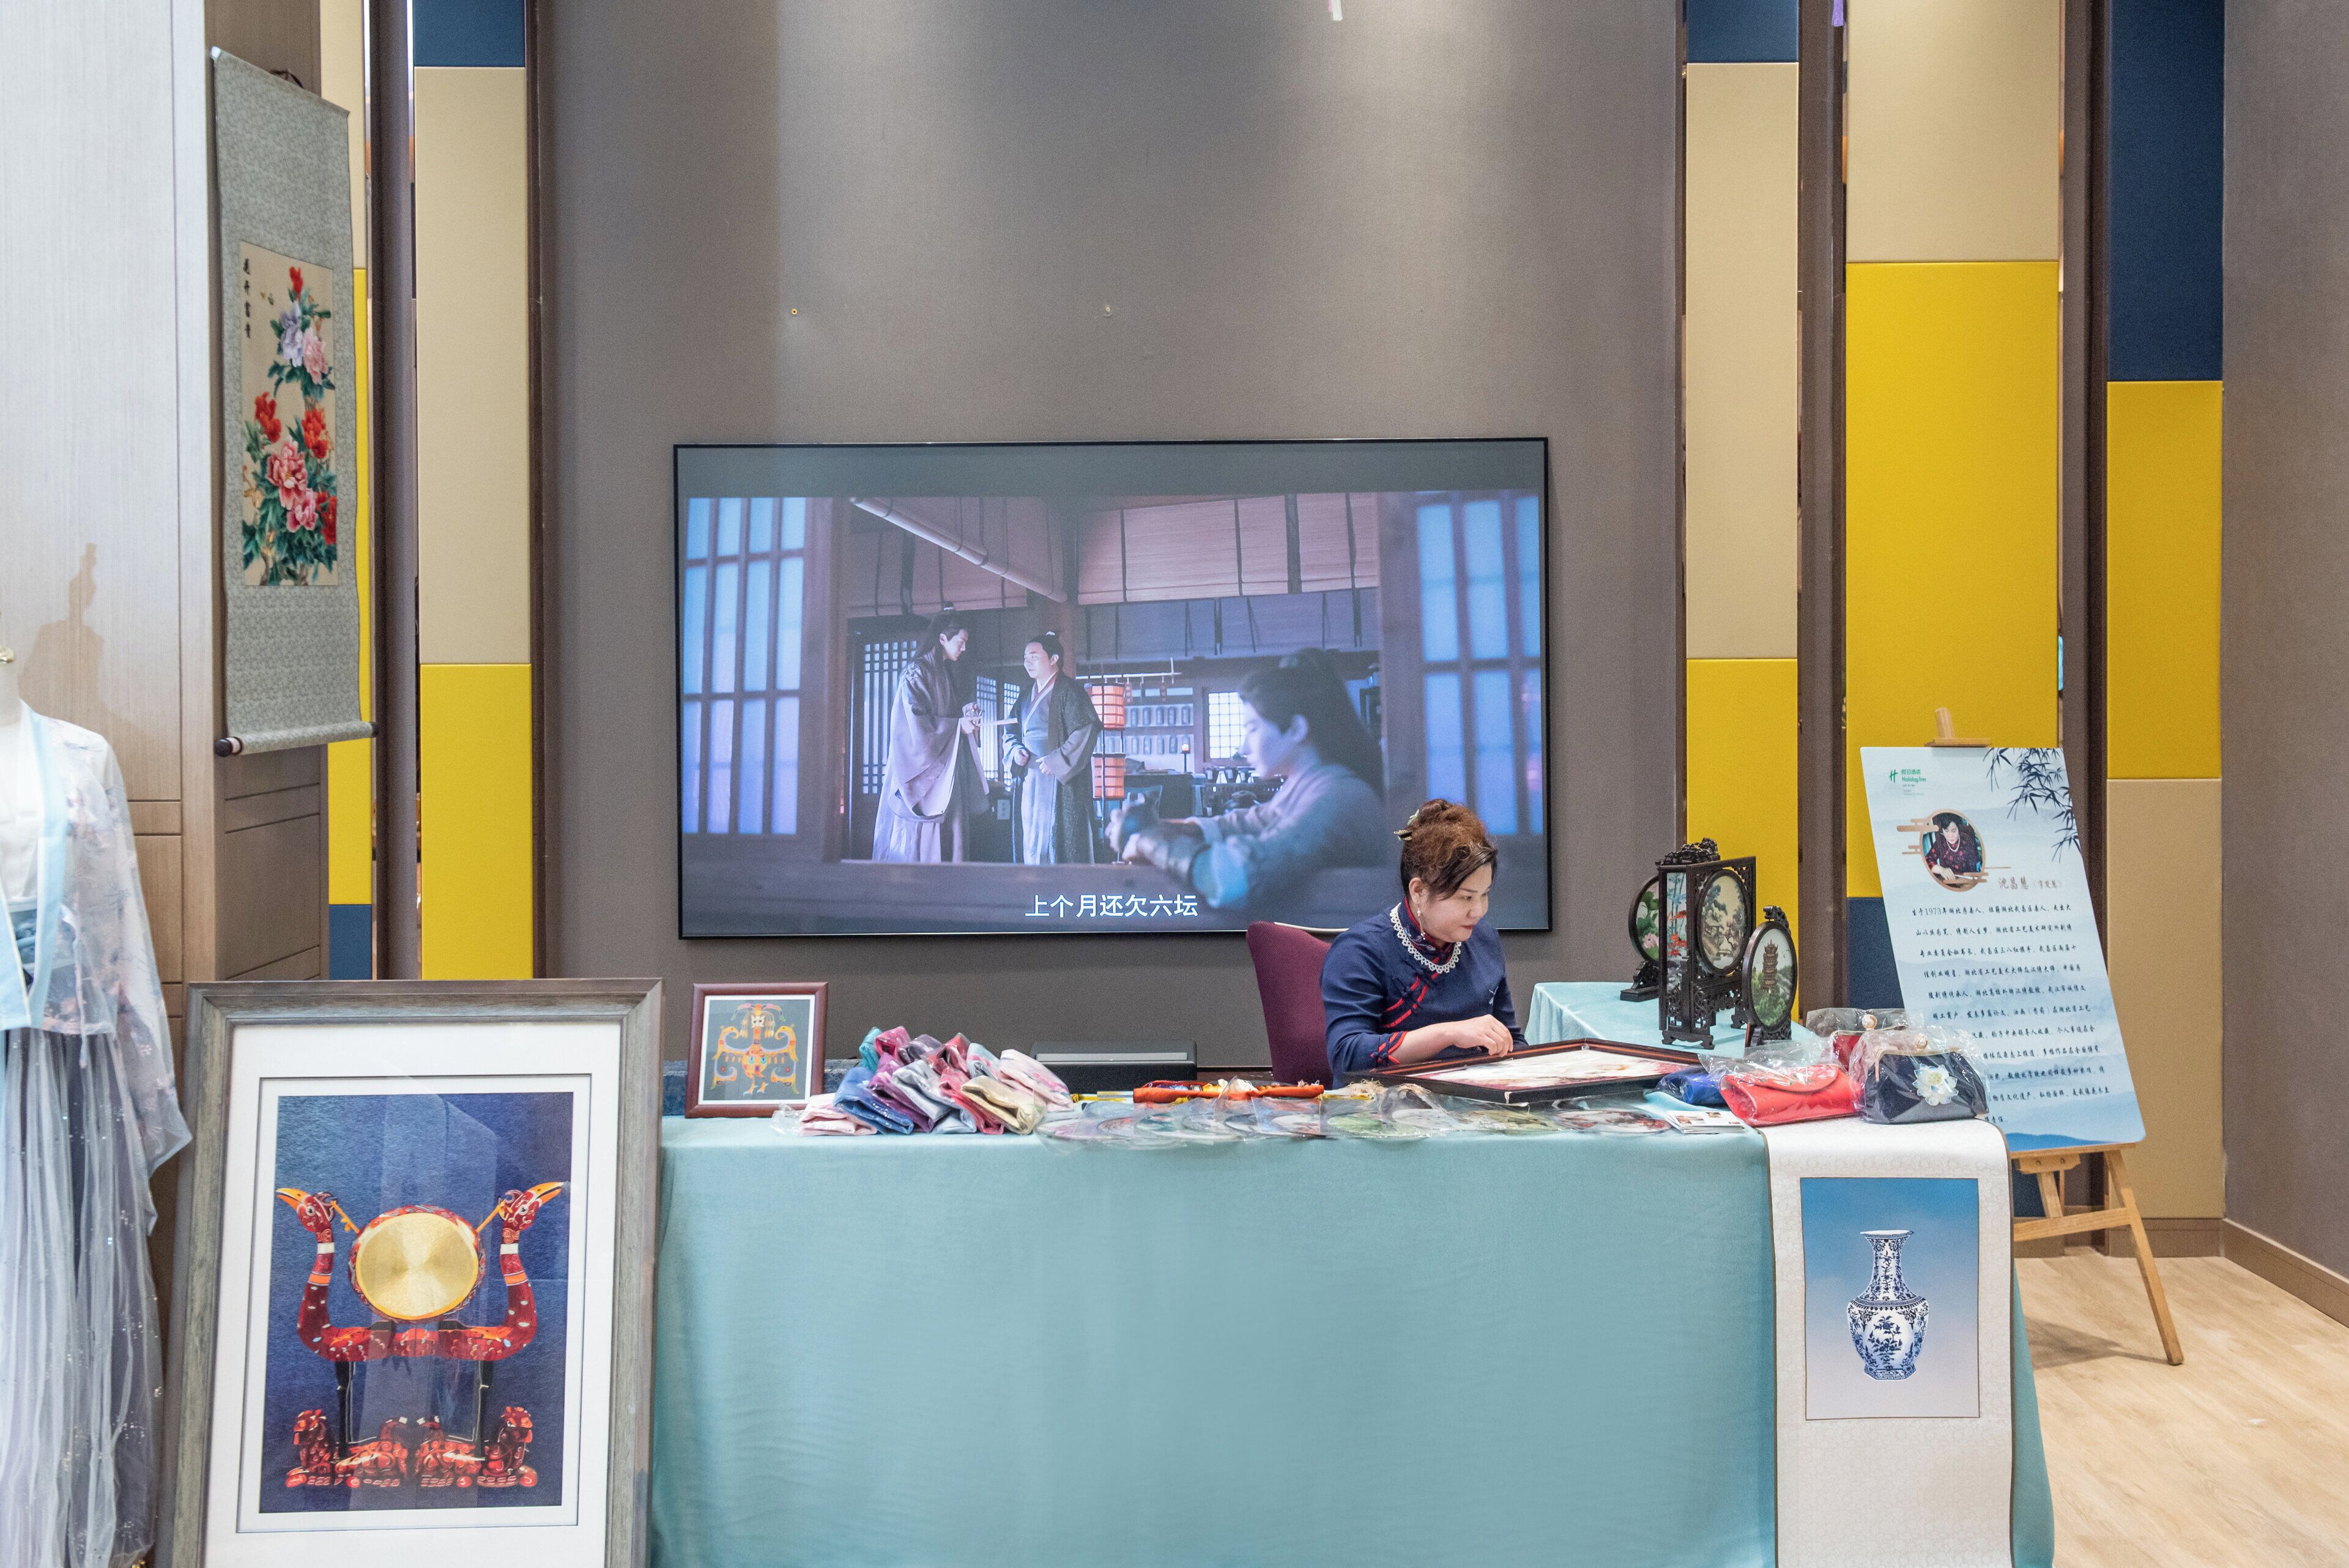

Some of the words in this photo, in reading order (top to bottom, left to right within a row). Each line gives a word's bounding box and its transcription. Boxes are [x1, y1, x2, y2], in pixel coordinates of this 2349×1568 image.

[1025, 894, 1198, 918] 上个月还欠六坛
